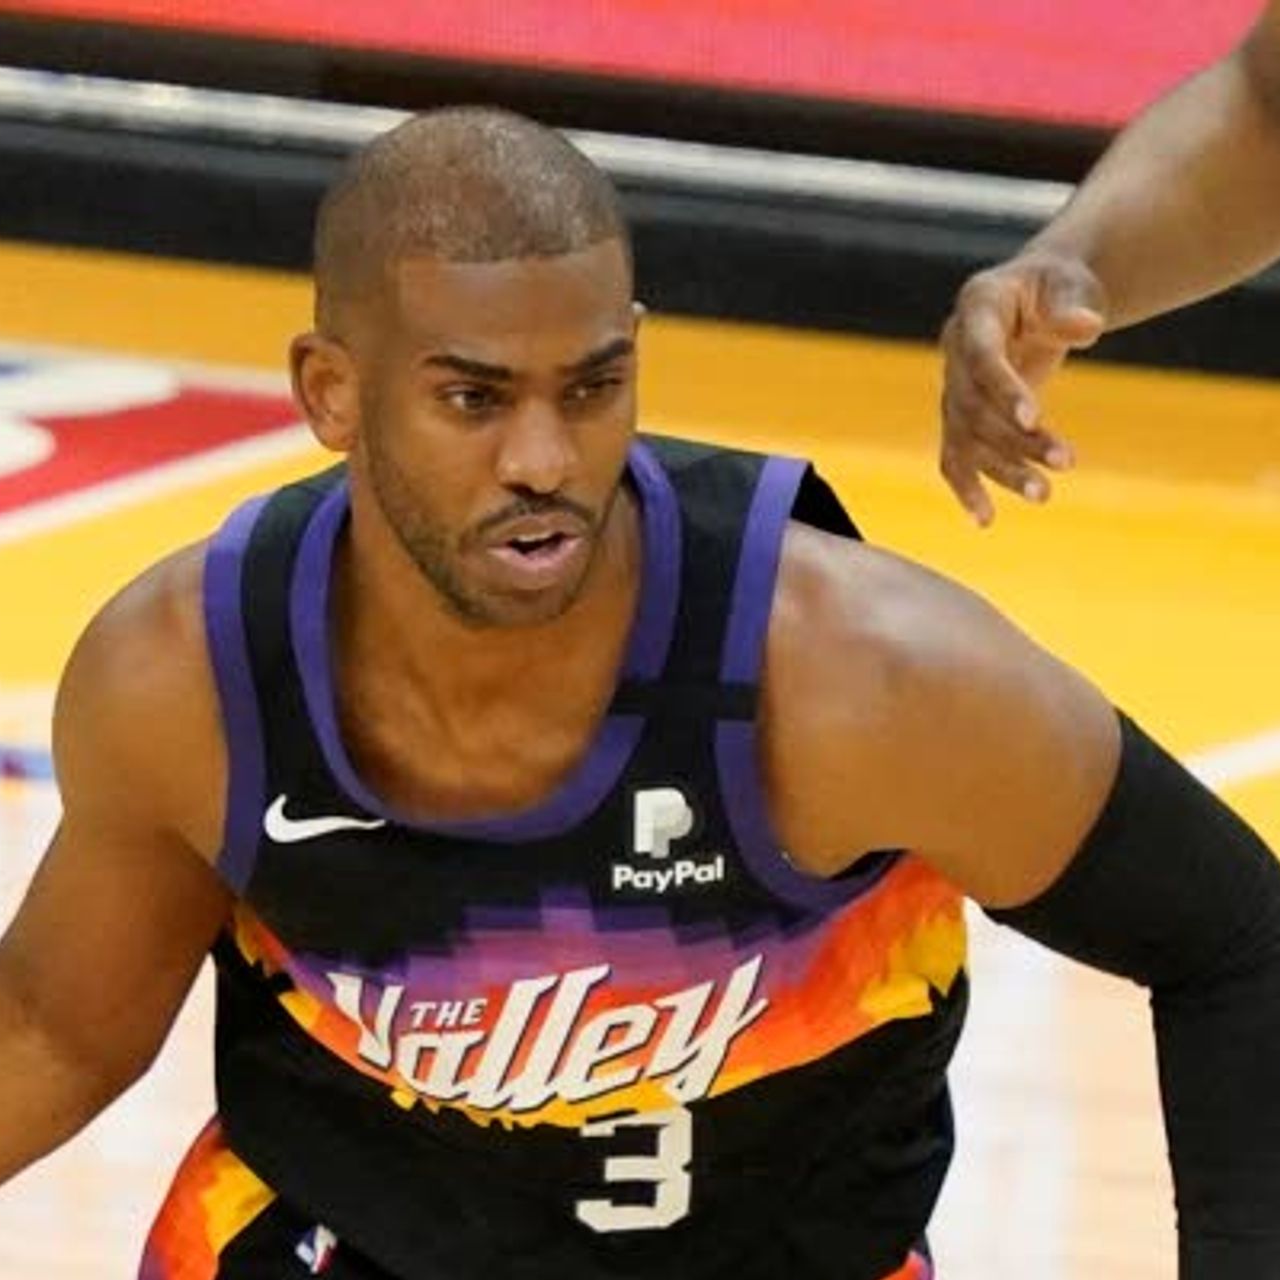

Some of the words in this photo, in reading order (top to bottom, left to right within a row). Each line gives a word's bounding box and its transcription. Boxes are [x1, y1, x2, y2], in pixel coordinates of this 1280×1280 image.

[612, 856, 724, 893] PayPal
[325, 953, 770, 1111] Valley
[410, 999, 488, 1028] THE
[576, 1106, 693, 1233] 3
